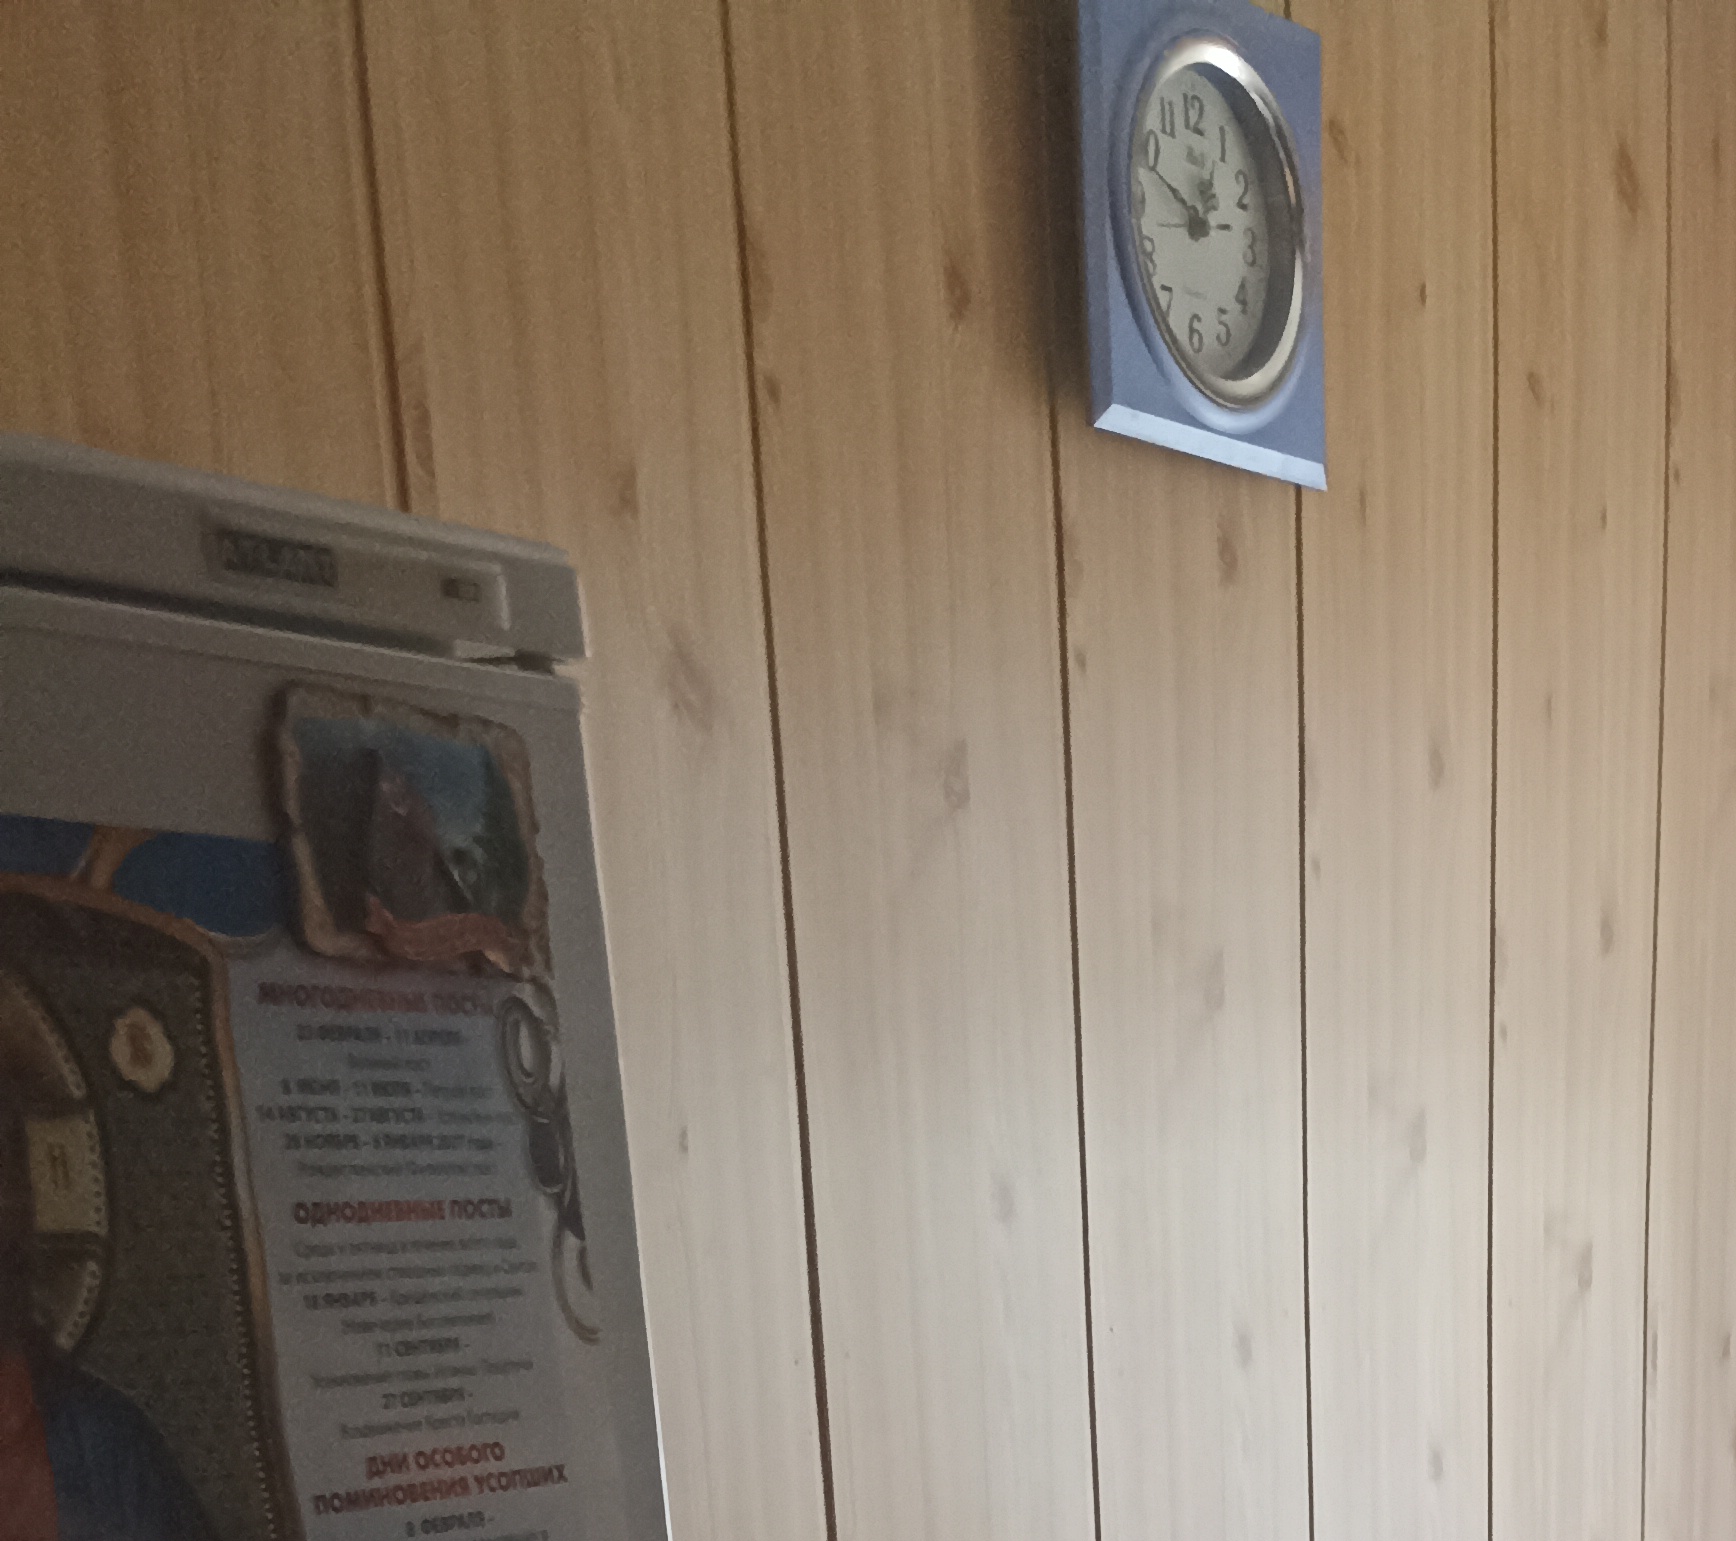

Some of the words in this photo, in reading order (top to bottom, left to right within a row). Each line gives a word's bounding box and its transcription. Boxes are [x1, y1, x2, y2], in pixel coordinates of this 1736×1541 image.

[1159, 96, 1176, 139] 11
[1182, 91, 1205, 137] 12
[1219, 125, 1227, 164] 1
[1234, 168, 1249, 212] 2
[1242, 227, 1257, 267] 3
[1160, 283, 1174, 323] 7
[1188, 313, 1204, 354] 6
[1216, 306, 1232, 346] 5
[365, 1455, 409, 1481] ДНИ
[414, 1441, 506, 1472] ОСОБОГО
[473, 1463, 569, 1496] УСОПШИХ
